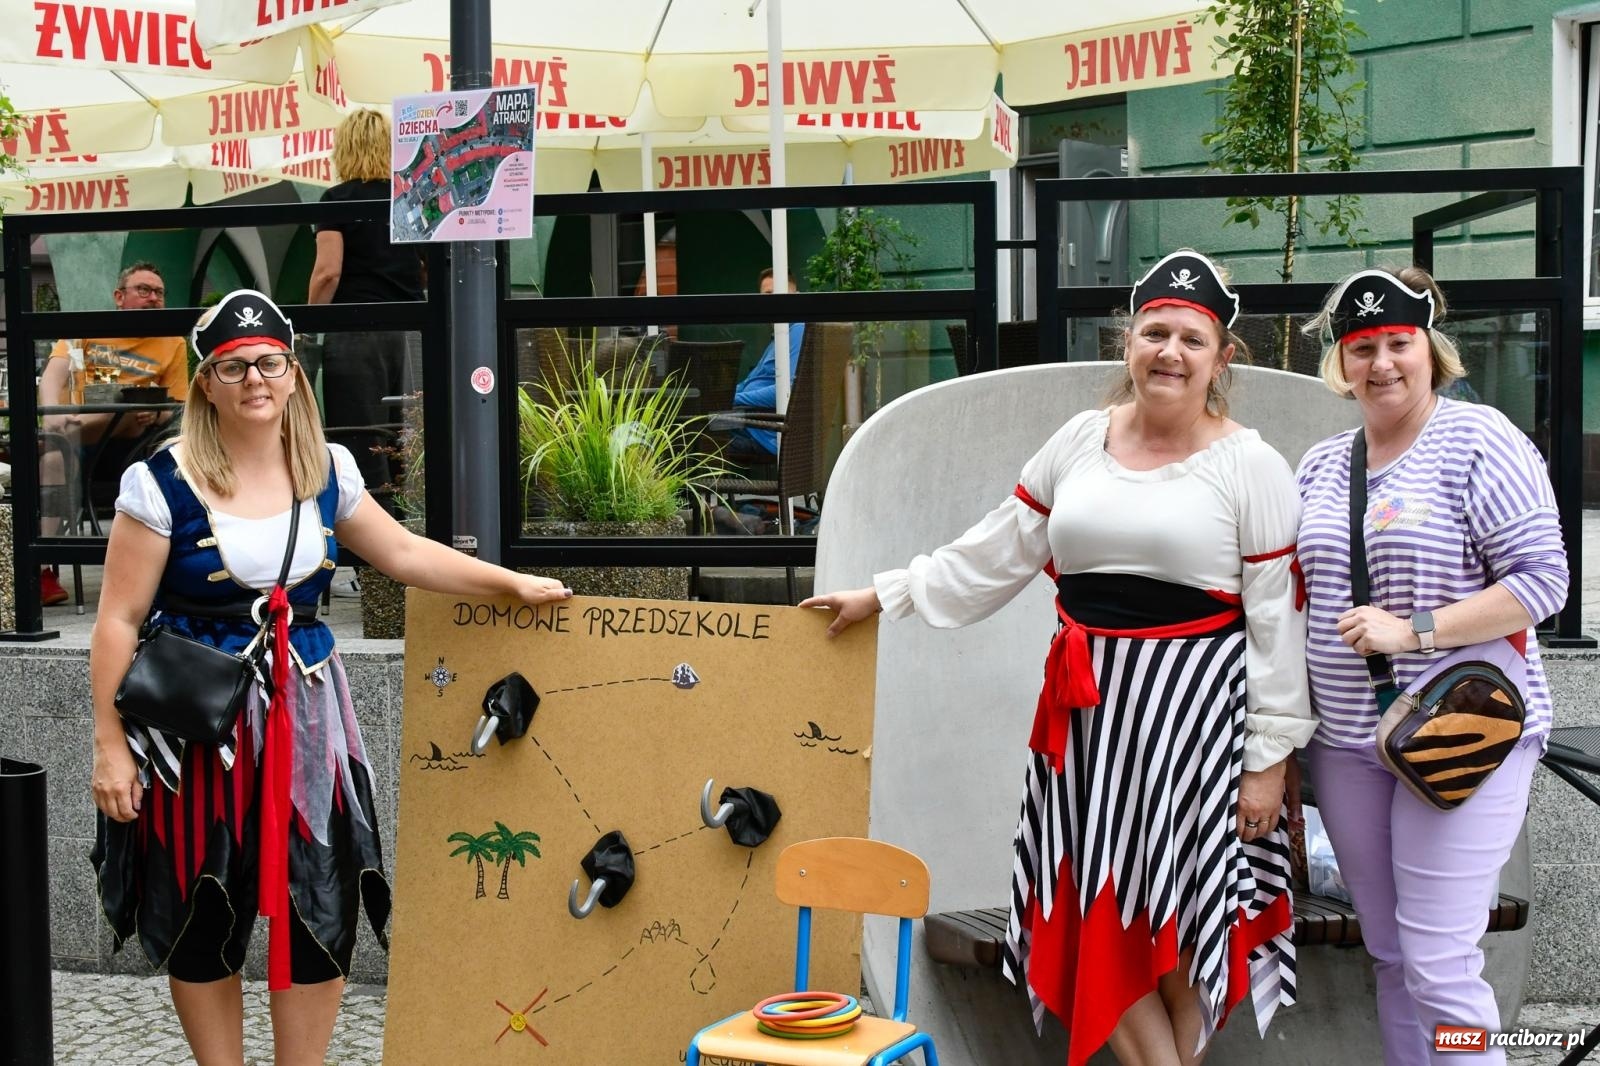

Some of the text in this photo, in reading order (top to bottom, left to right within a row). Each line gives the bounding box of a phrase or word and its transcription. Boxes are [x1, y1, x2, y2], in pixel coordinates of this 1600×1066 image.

[496, 93, 528, 111] MAPA
[493, 109, 530, 125] ATRAKCJI
[399, 120, 439, 135] DZIECKA
[453, 602, 770, 639] DOMOWE PRZEDSZKOLE
[438, 656, 444, 665] N
[452, 672, 457, 682] E
[437, 689, 444, 697] S
